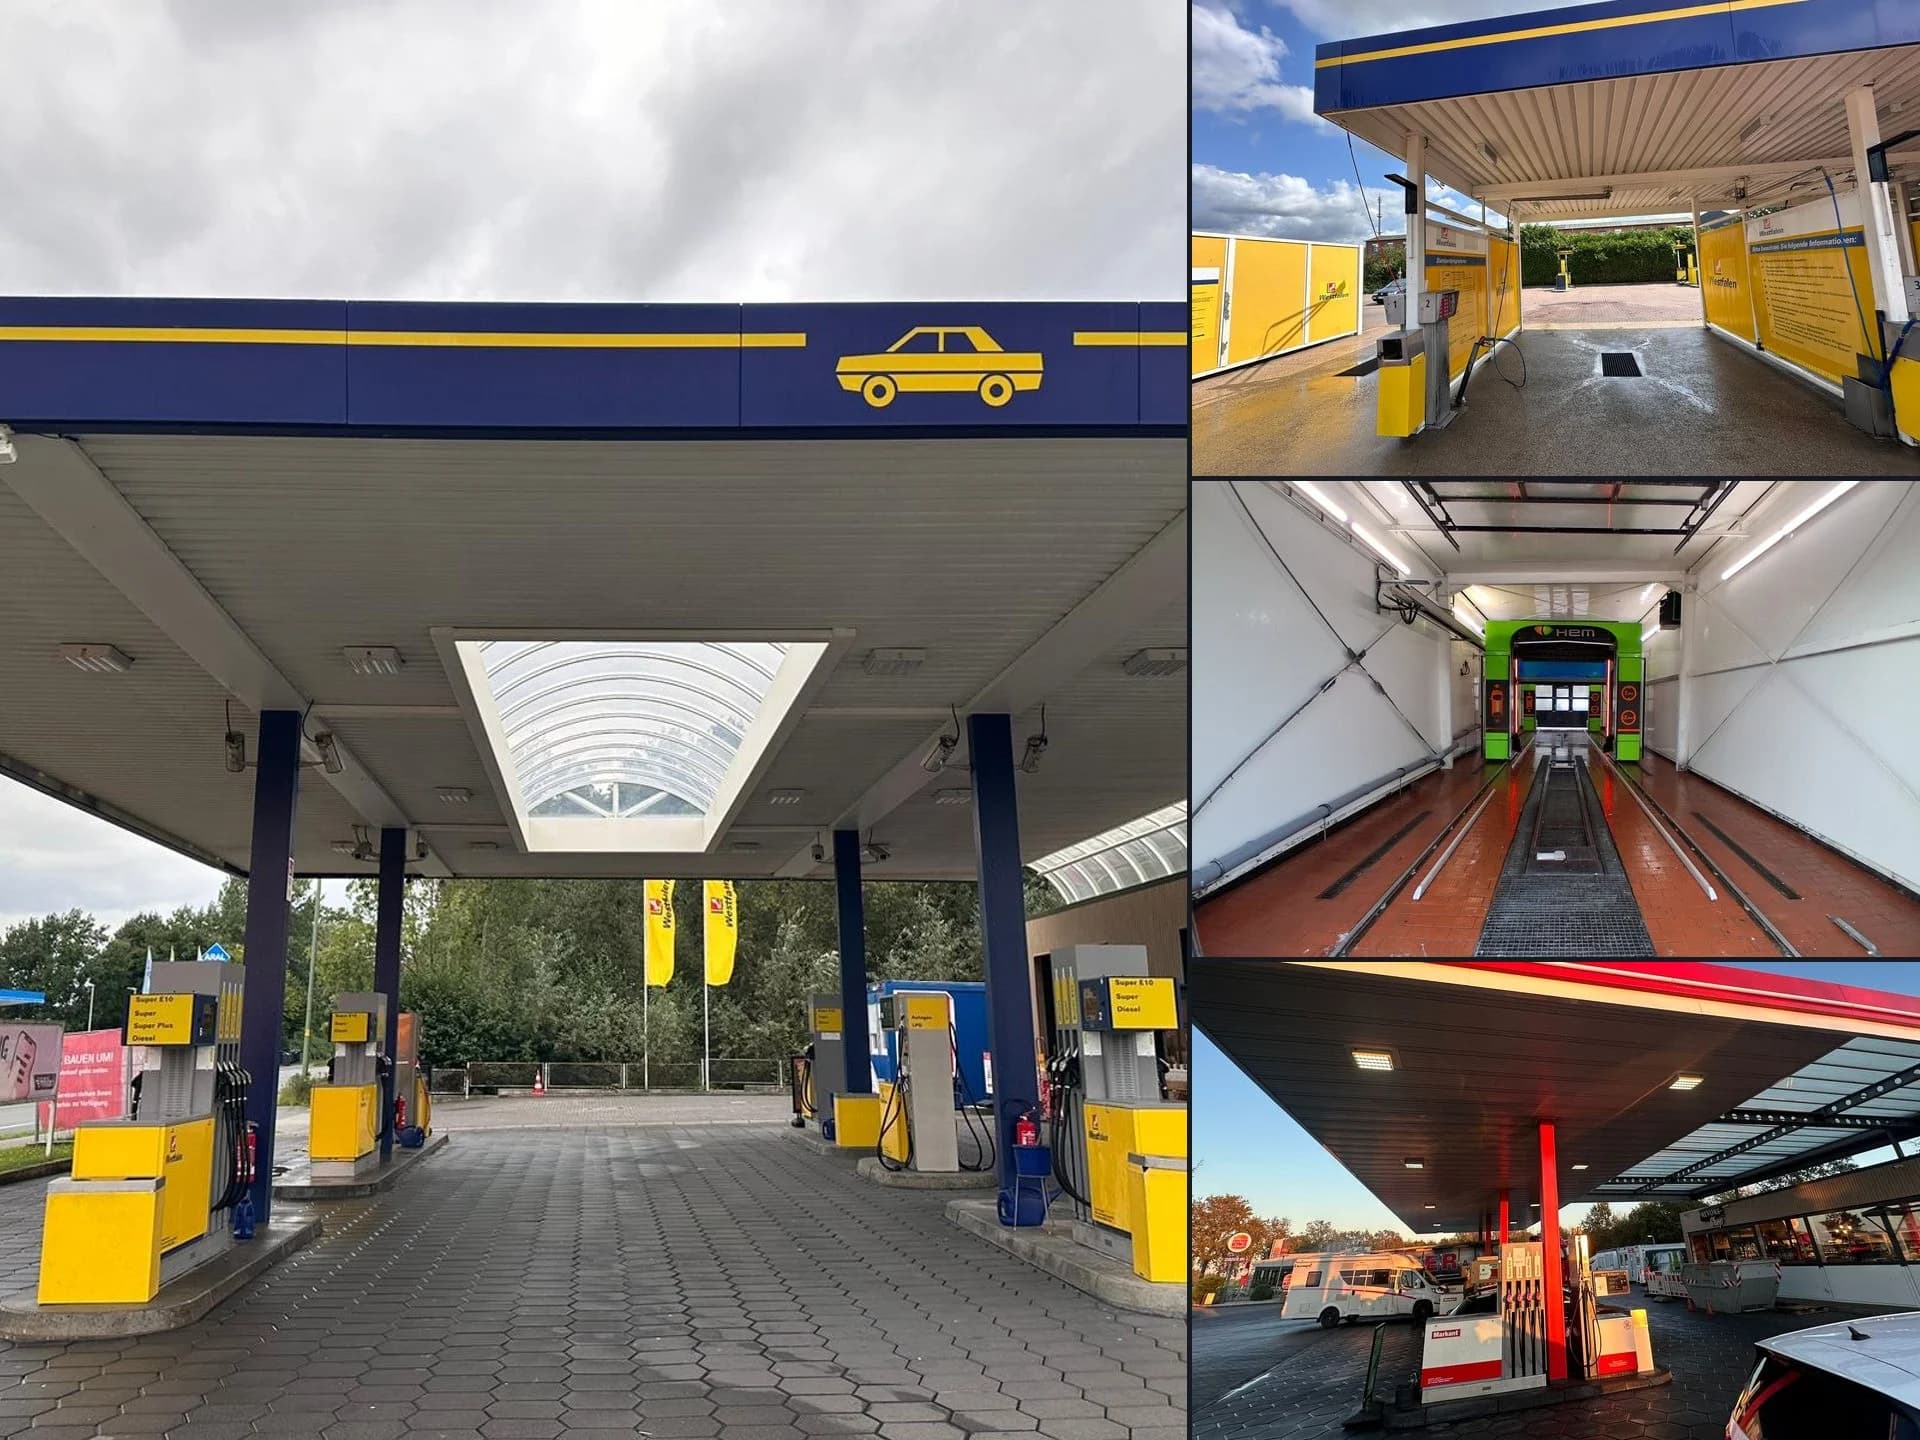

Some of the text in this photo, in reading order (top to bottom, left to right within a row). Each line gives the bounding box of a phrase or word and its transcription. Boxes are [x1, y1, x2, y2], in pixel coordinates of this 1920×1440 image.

[1809, 236, 1857, 248] Informatioen:
[1393, 300, 1398, 309] 1
[1425, 300, 1431, 308] 2
[1115, 979, 1137, 987] Super
[135, 996, 157, 1004] Super
[1116, 993, 1138, 1001] Super
[134, 1010, 157, 1018] Super
[133, 1022, 155, 1030] Super
[1433, 1329, 1459, 1338] Markant
